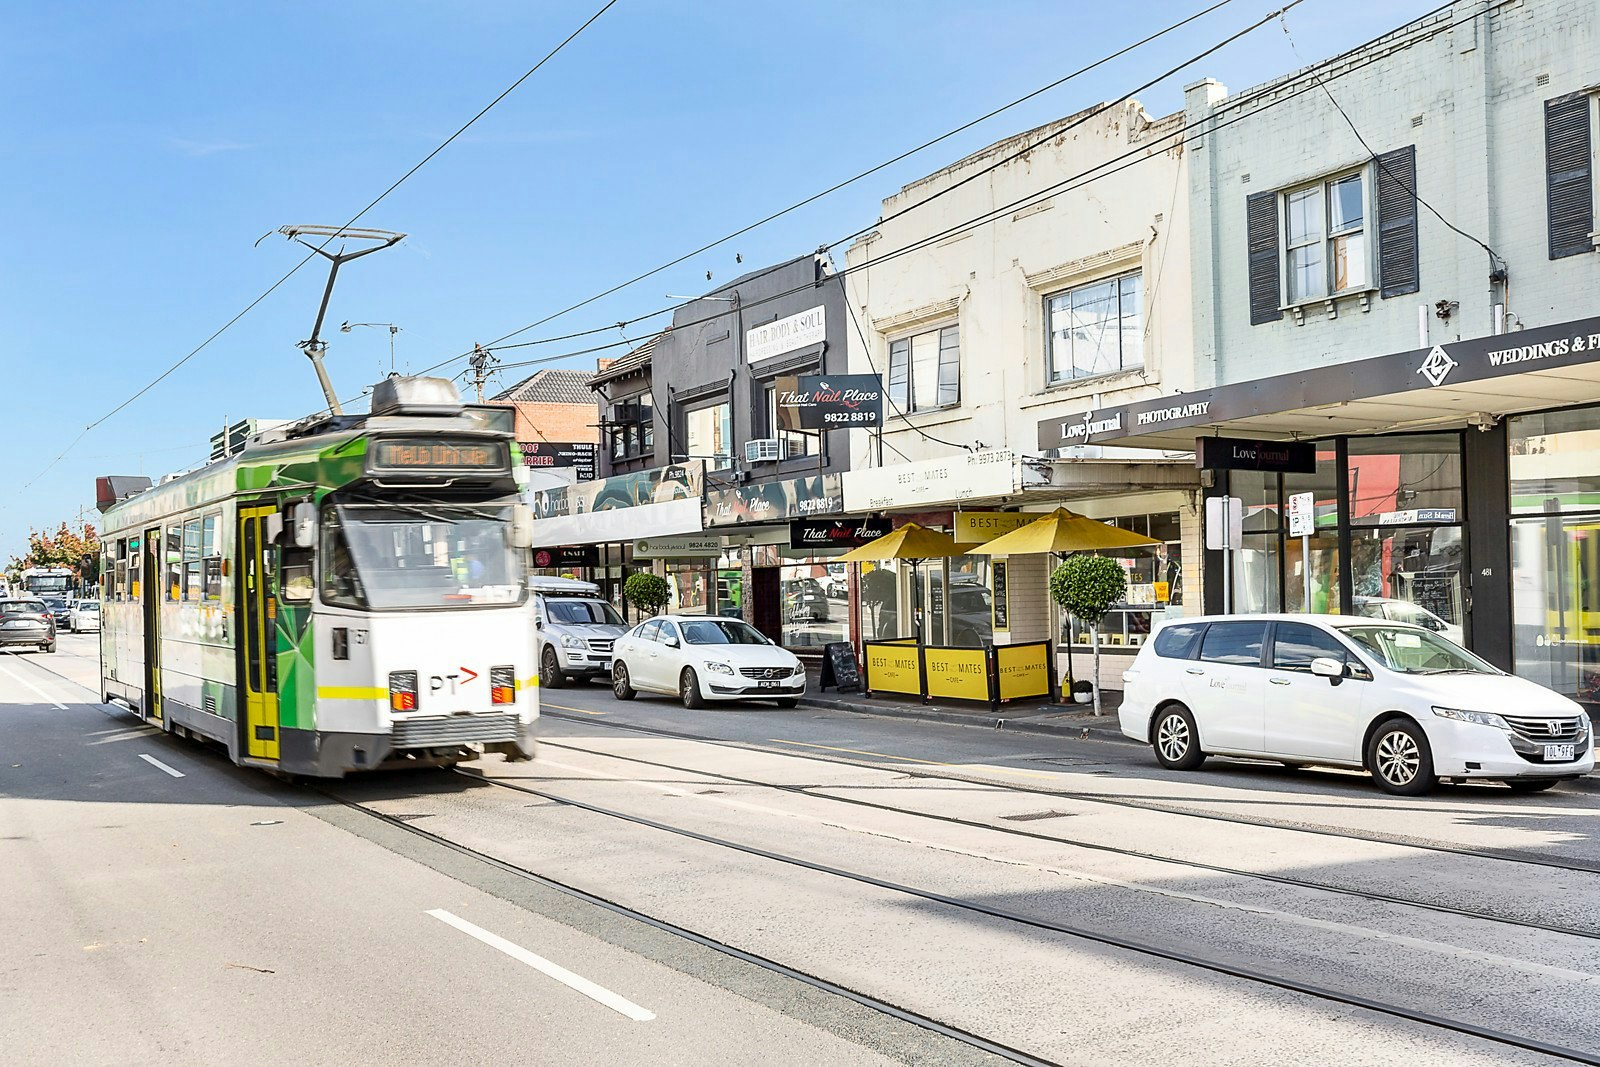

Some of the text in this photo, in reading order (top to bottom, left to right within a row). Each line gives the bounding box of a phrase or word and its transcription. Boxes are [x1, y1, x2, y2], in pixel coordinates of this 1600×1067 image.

[771, 322, 791, 341] BODY
[793, 319, 799, 334] &
[801, 311, 823, 331] SOUL
[1488, 338, 1569, 367] WEDDINGS
[1572, 336, 1585, 351] &
[780, 388, 879, 403] That Nail Place
[824, 411, 876, 423] 9822 8819
[1137, 401, 1211, 426] PHOTOGRAPHY
[519, 443, 538, 453] OOF
[1233, 446, 1257, 459] Love
[978, 452, 994, 465] 9973
[995, 450, 1012, 463] 2873
[898, 468, 948, 484] BEST MATES
[800, 497, 832, 512] 9822 8819
[869, 488, 973, 508] Breakfast Lunch
[716, 497, 770, 515] That Nail Place
[970, 518, 999, 528] BEST
[803, 527, 882, 539] That Nail Place
[1481, 568, 1492, 576] 481
[872, 657, 916, 670] BEST MATES
[931, 661, 982, 675] BEST MATES
[999, 663, 1047, 674] BEST MATES
